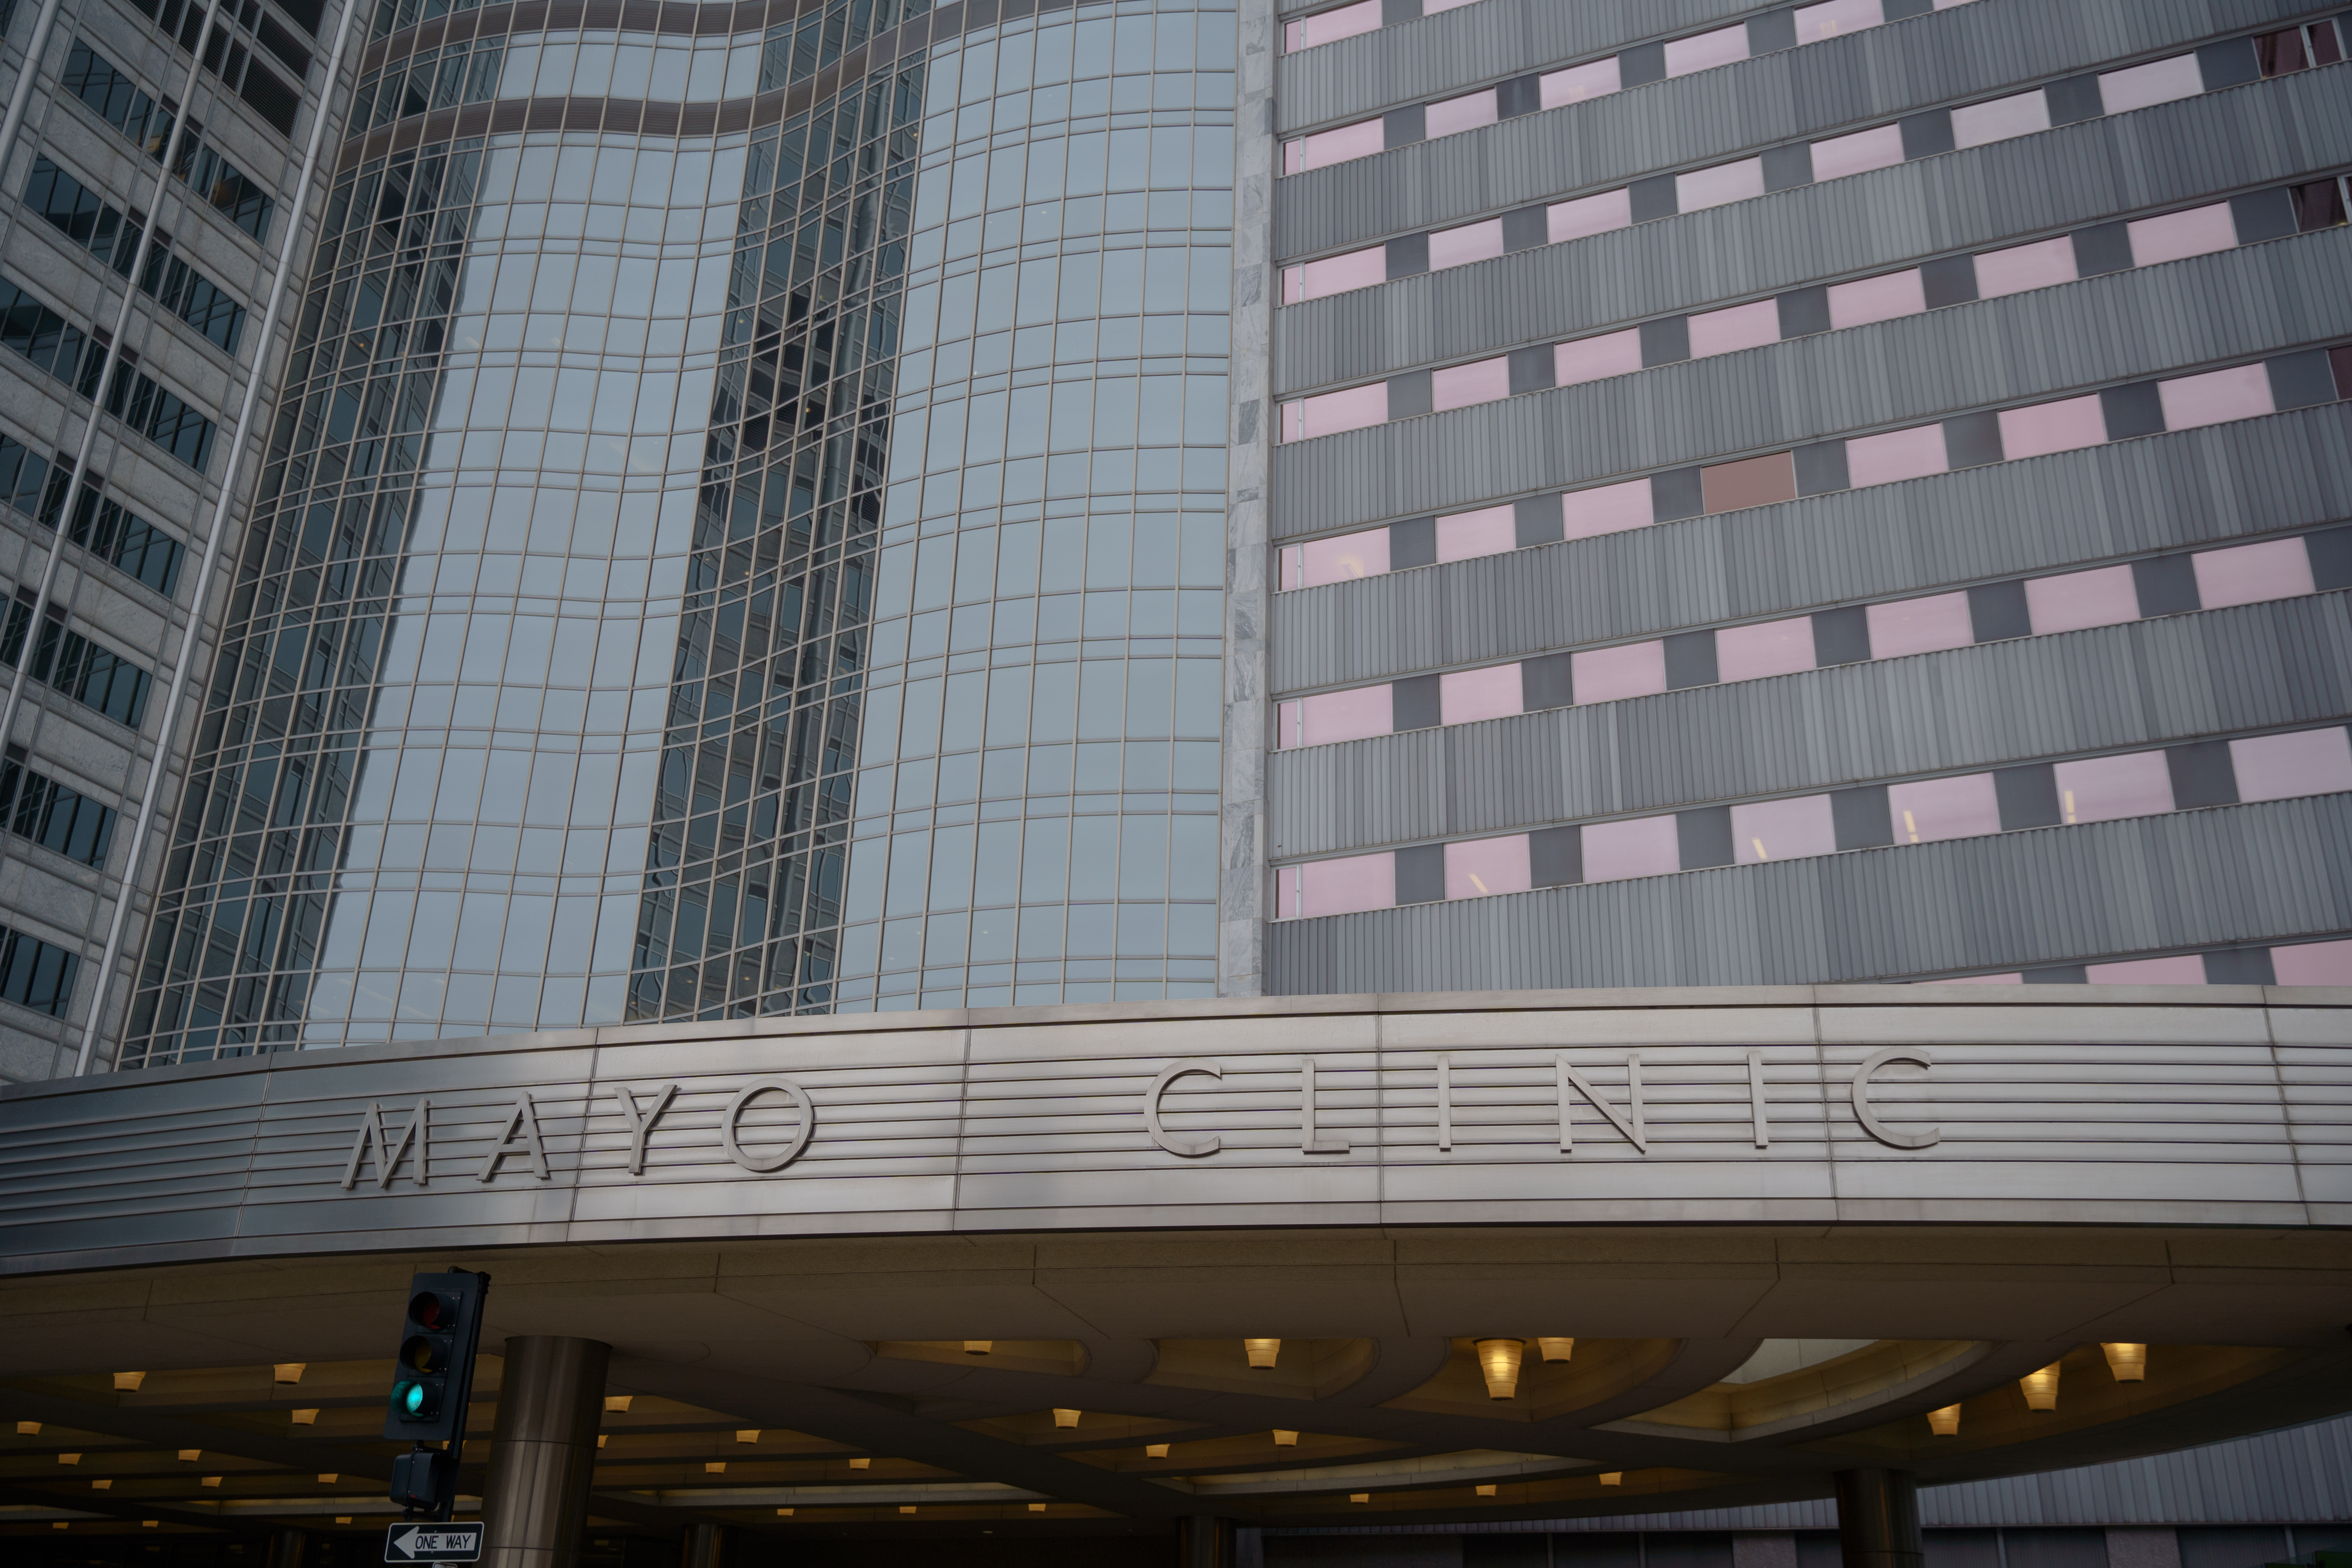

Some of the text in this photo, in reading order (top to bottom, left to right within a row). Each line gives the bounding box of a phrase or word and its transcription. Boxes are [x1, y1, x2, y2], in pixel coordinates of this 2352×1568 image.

[340, 1047, 1940, 1189] MAYO CLINIC
[415, 1534, 472, 1549] ONE WAY
